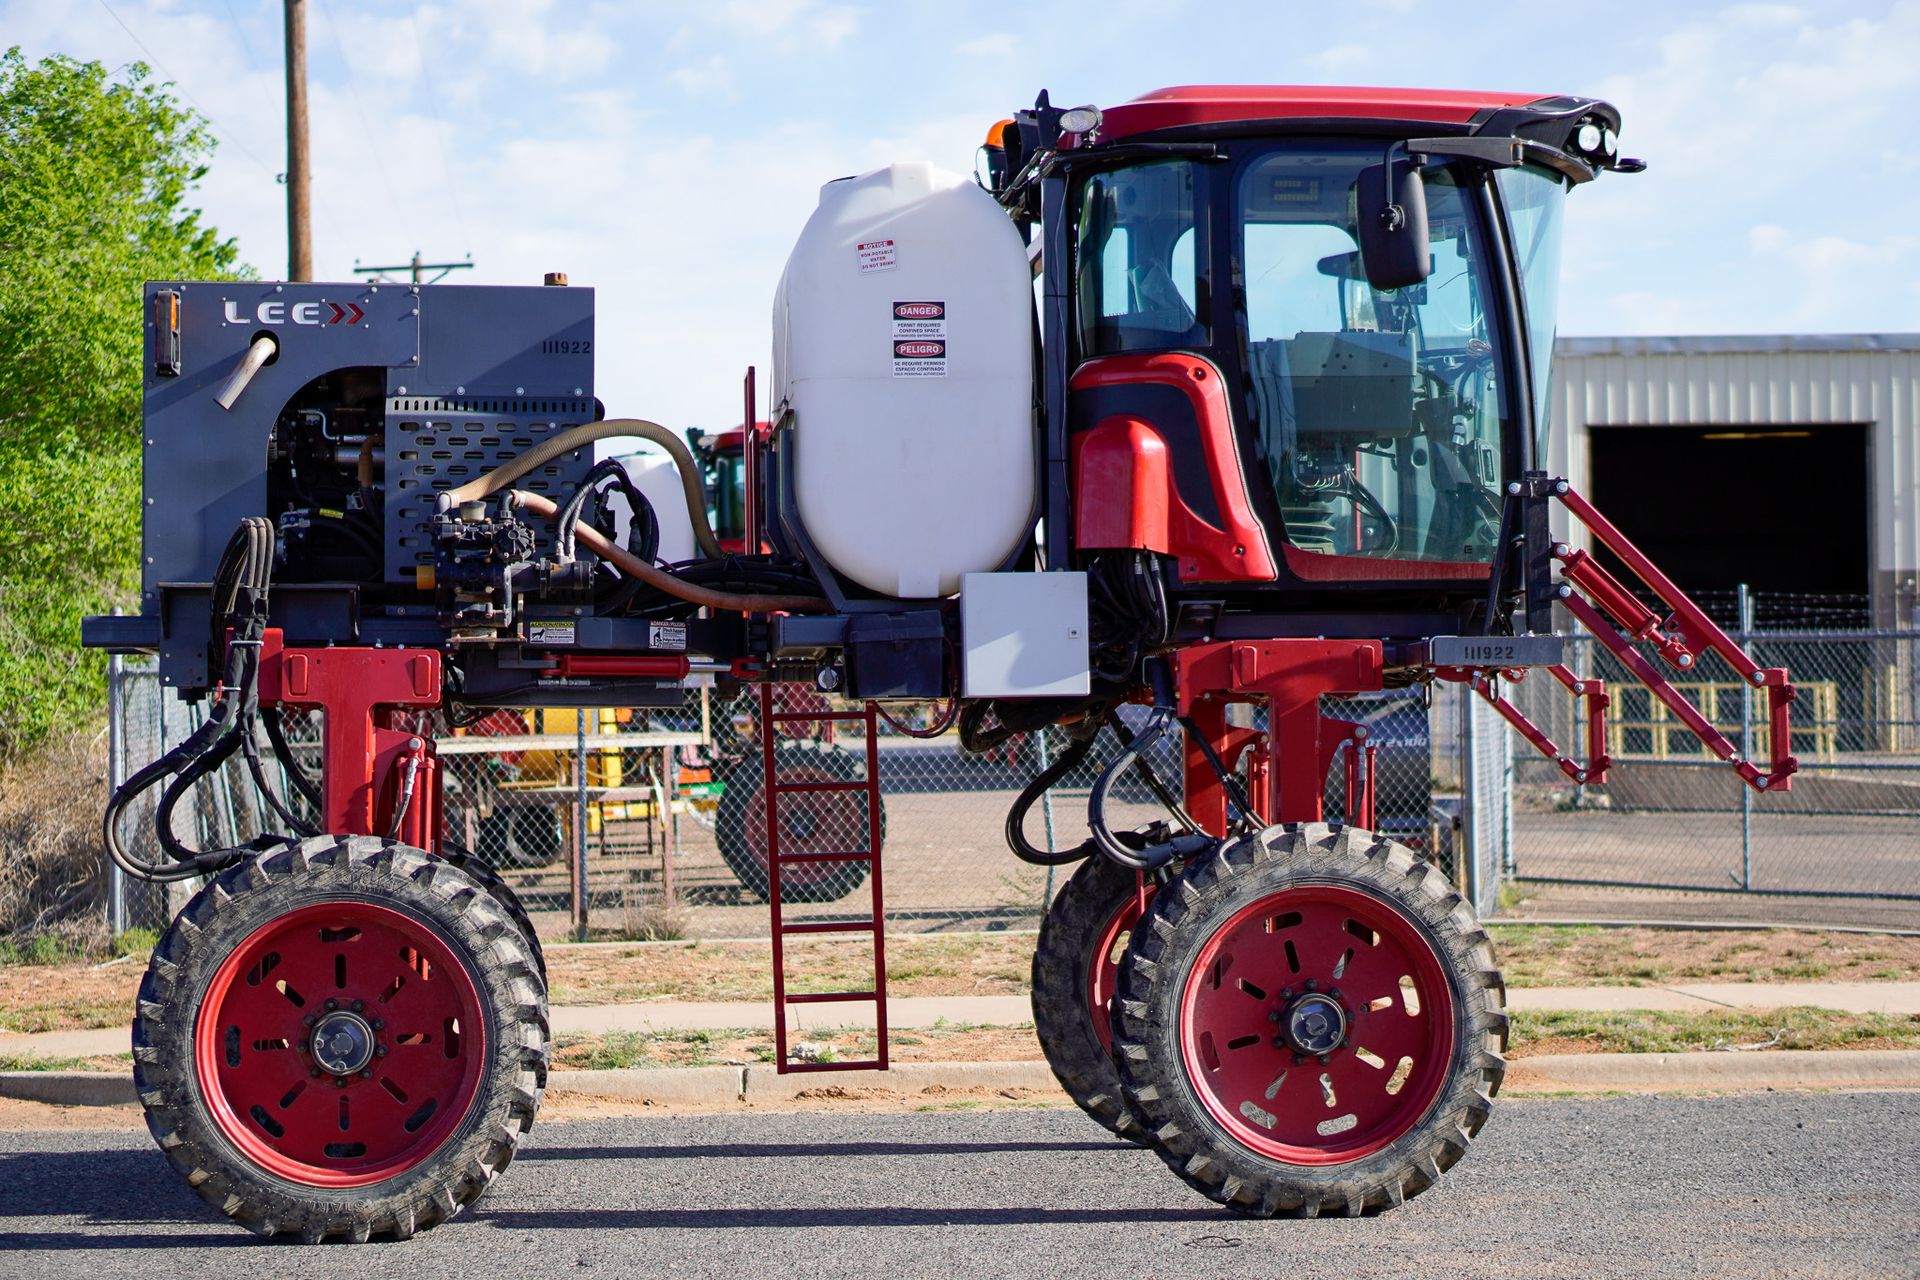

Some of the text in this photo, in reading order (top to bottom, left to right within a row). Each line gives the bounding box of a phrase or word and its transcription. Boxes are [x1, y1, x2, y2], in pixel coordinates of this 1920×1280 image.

[863, 241, 888, 249] NOTICE
[225, 301, 319, 324] LEE
[900, 307, 938, 315] DANGER
[543, 341, 591, 354] 111922
[900, 345, 939, 354] PELIGRO
[1465, 646, 1514, 659] 111922
